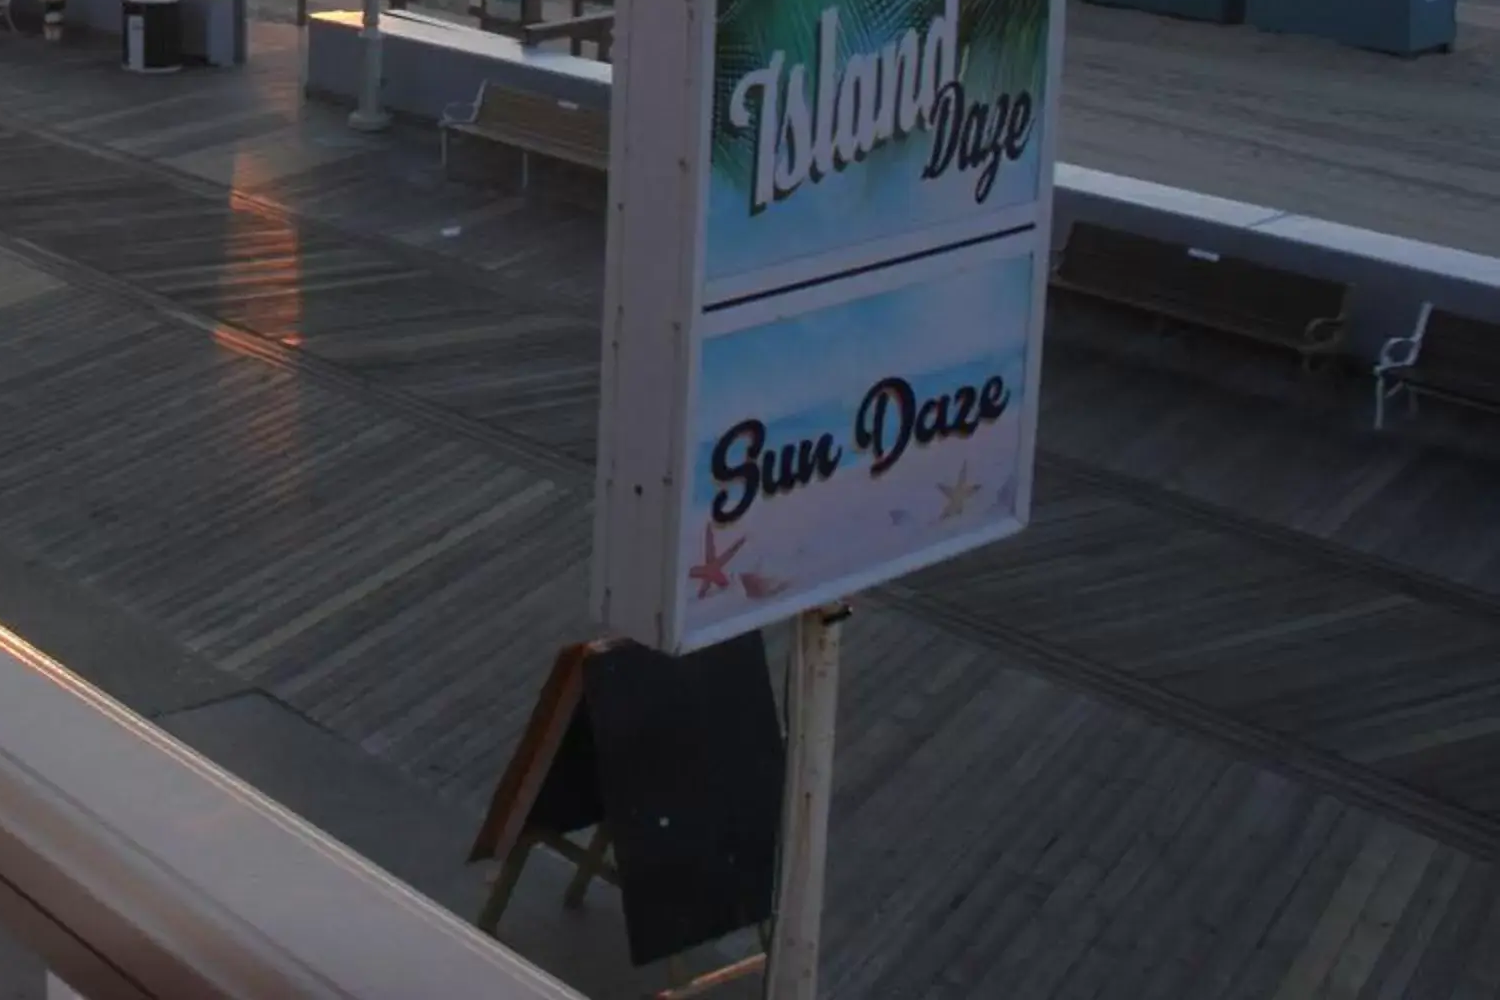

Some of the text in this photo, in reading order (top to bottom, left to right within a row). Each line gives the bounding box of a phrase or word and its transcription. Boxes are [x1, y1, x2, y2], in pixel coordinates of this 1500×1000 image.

[922, 81, 1035, 203] Daze
[711, 377, 1010, 524] Sun Daze
